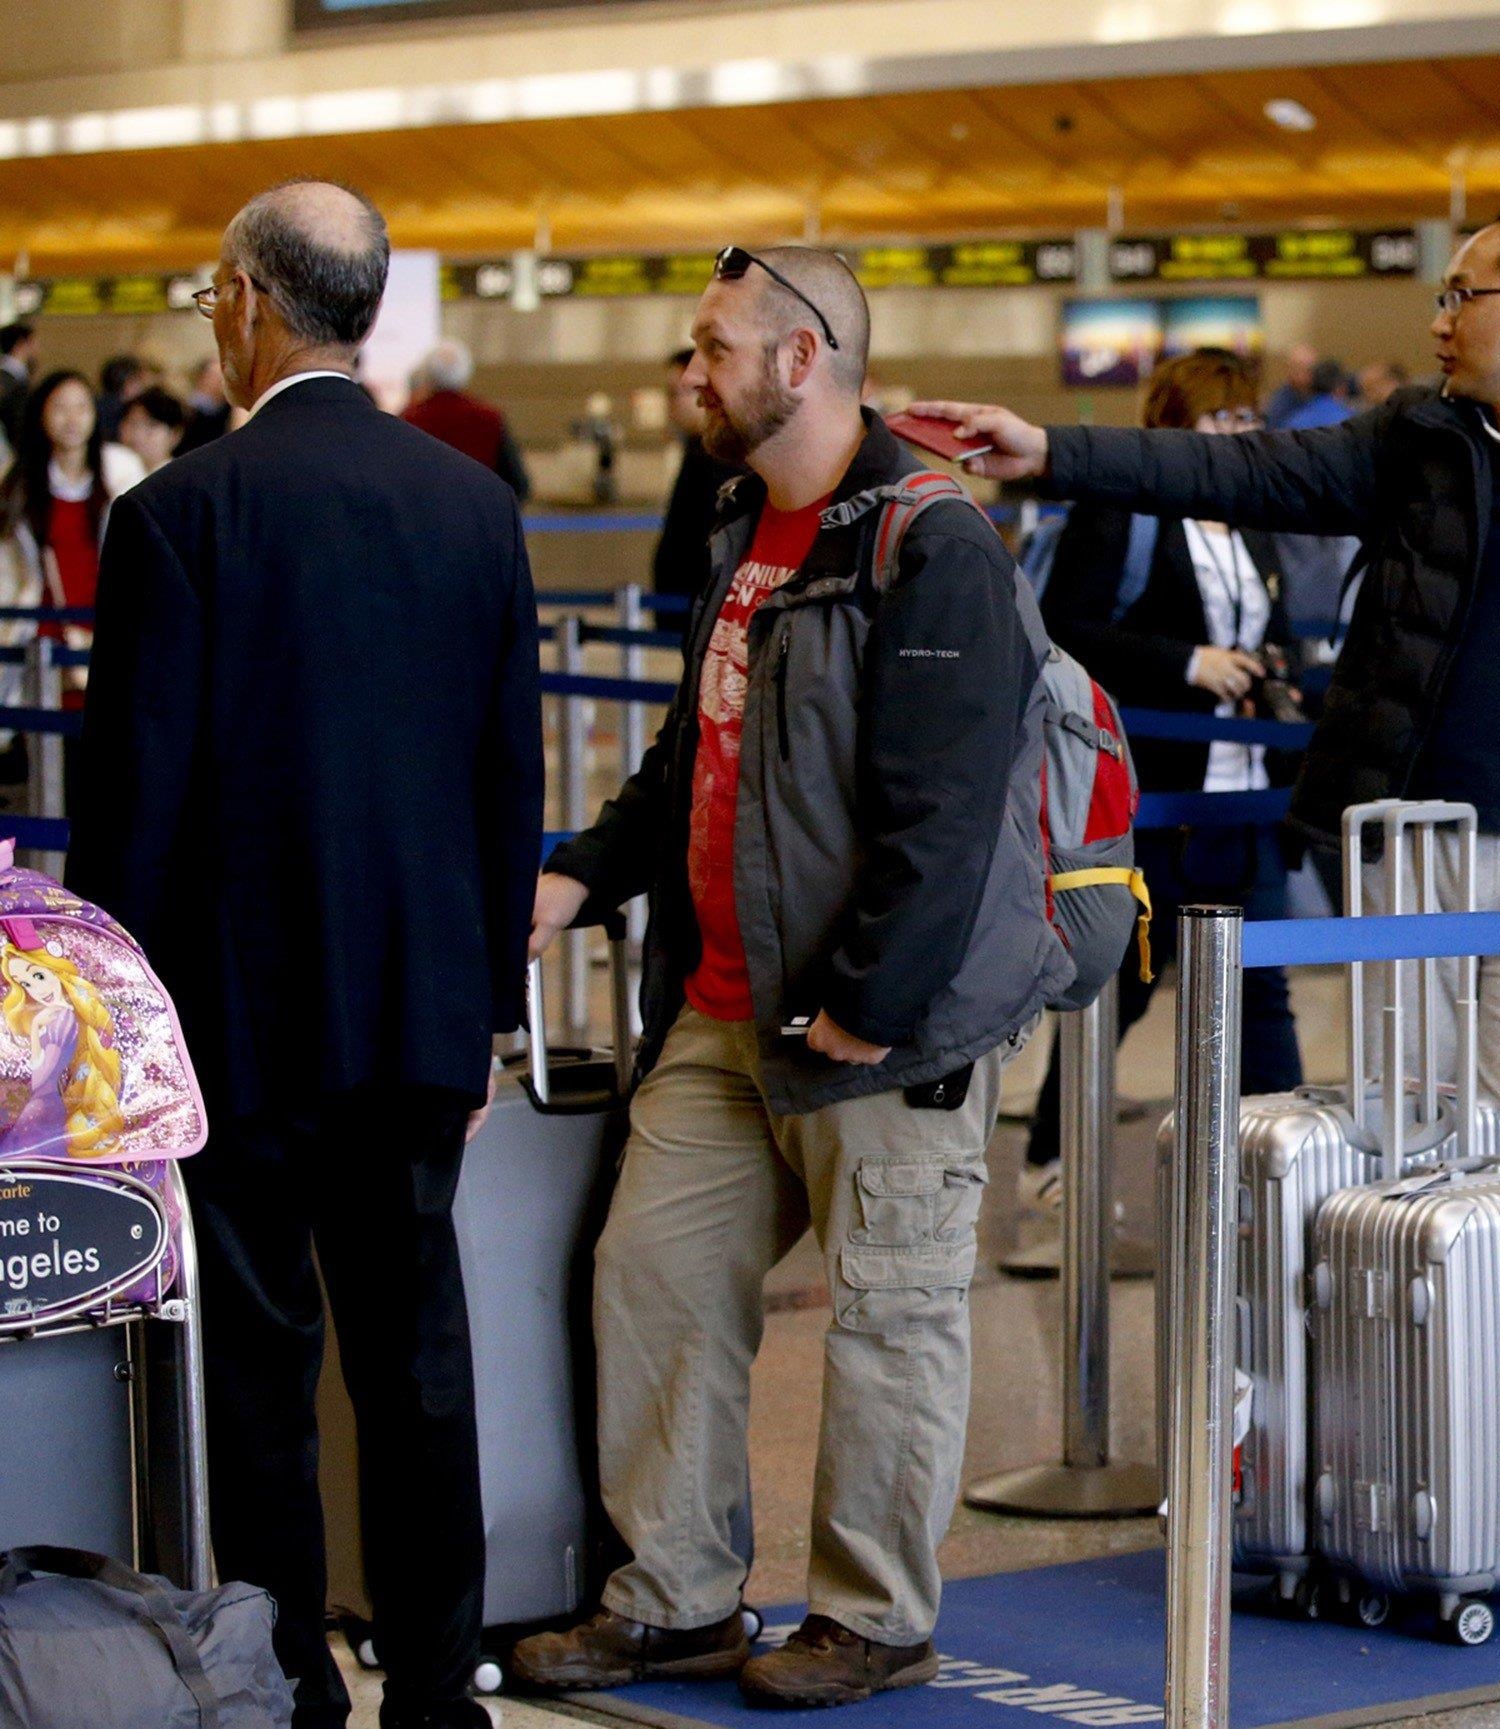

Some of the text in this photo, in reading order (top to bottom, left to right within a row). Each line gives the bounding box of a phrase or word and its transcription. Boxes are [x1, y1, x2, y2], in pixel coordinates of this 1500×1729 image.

[899, 649, 961, 659] HYDRO-TECH
[38, 1212, 60, 1233] to
[974, 1683, 1165, 1726] AIR
